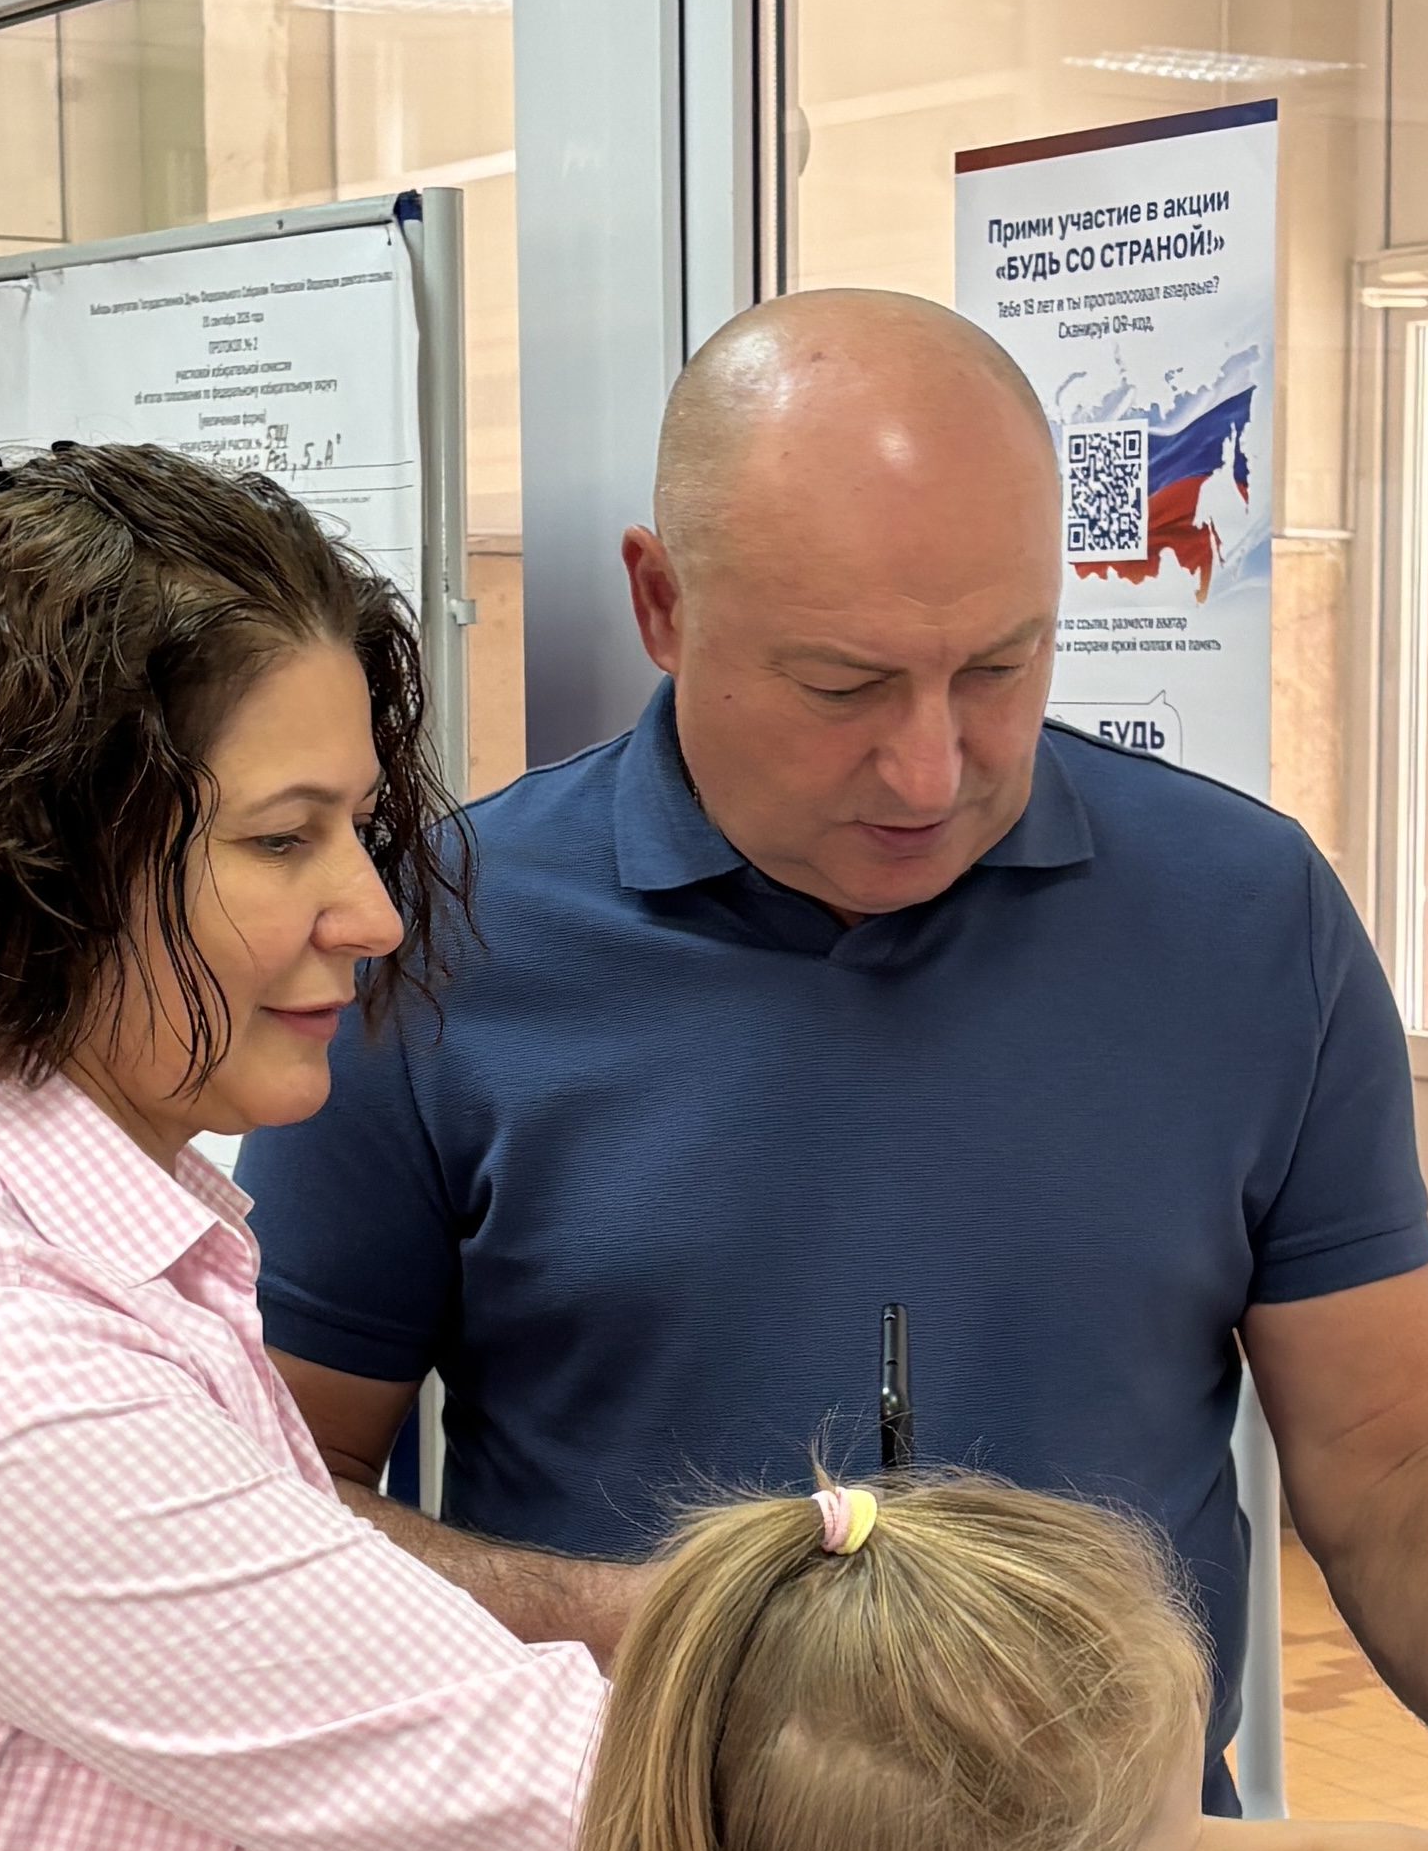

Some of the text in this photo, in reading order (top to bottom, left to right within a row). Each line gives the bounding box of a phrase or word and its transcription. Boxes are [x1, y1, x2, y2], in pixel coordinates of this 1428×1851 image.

[988, 190, 1230, 248] Прими участие в акции
[995, 224, 1226, 282] «БУДЬ СО СТРАНОЙ!»
[1098, 720, 1165, 750] БУДЬ
